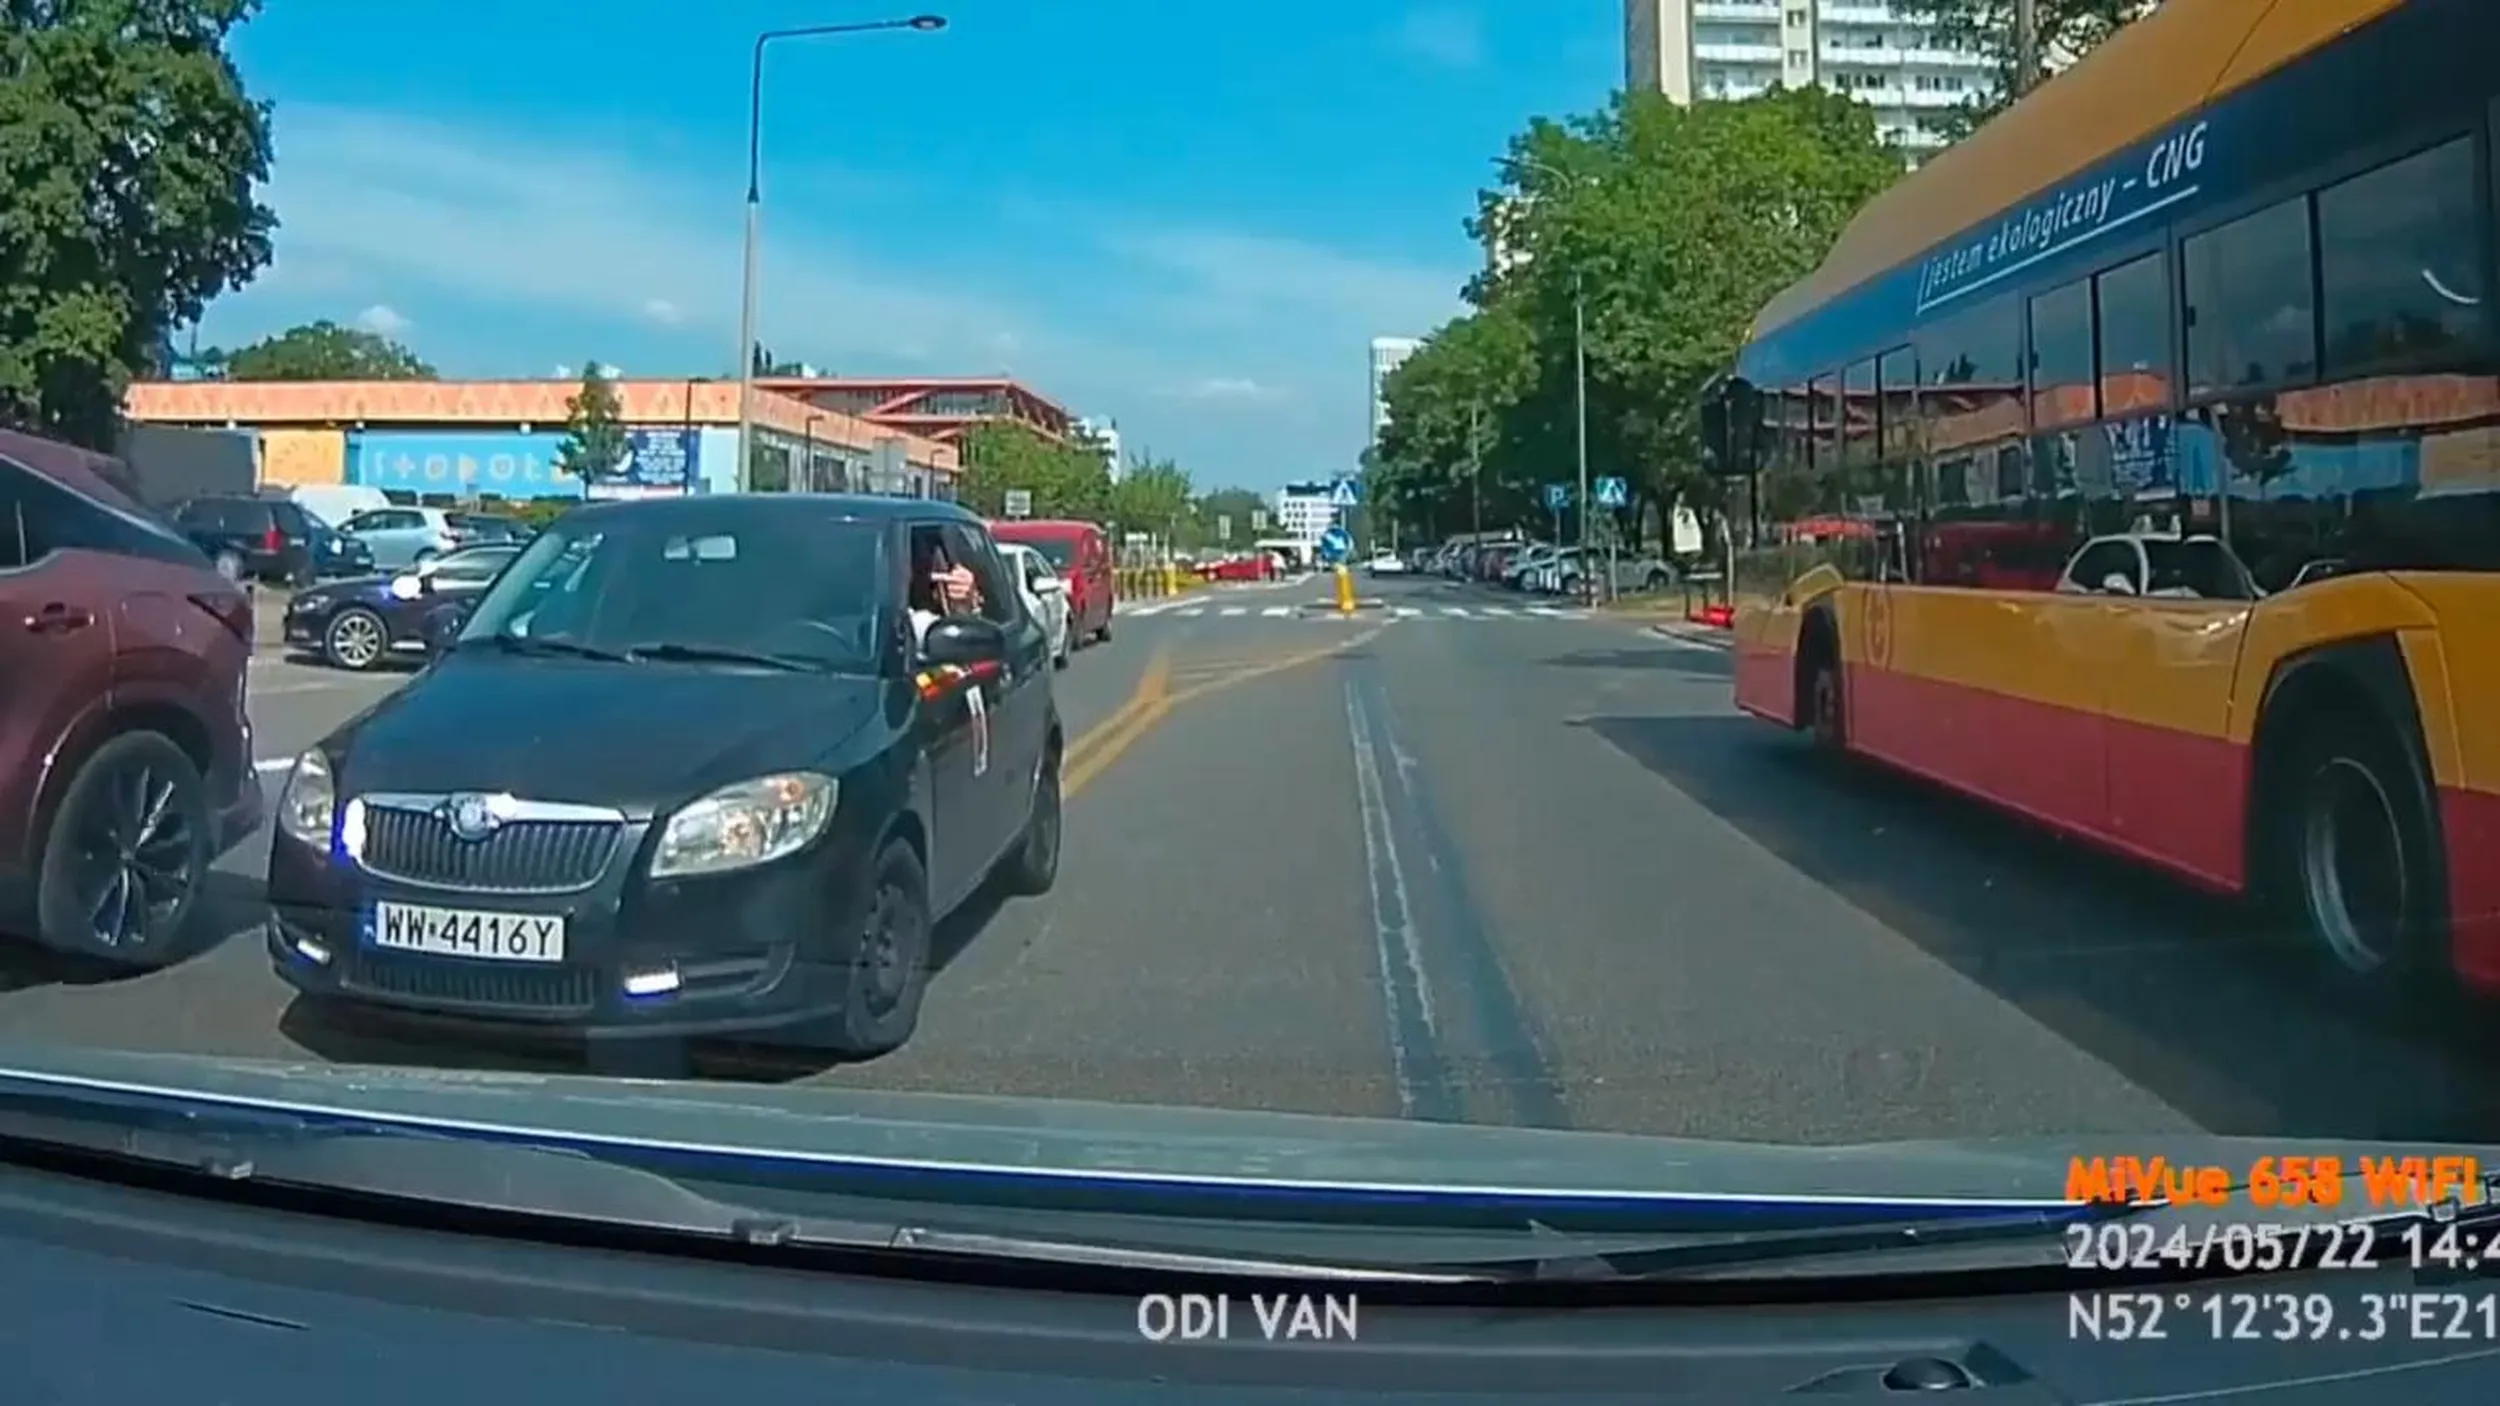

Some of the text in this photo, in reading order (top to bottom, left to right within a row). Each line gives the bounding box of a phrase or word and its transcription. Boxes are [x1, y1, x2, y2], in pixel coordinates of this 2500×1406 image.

[1925, 242, 1983, 297] jestem
[1987, 177, 2115, 263] ekologiczny
[2147, 121, 2208, 188] CNG
[1552, 487, 1565, 506] P
